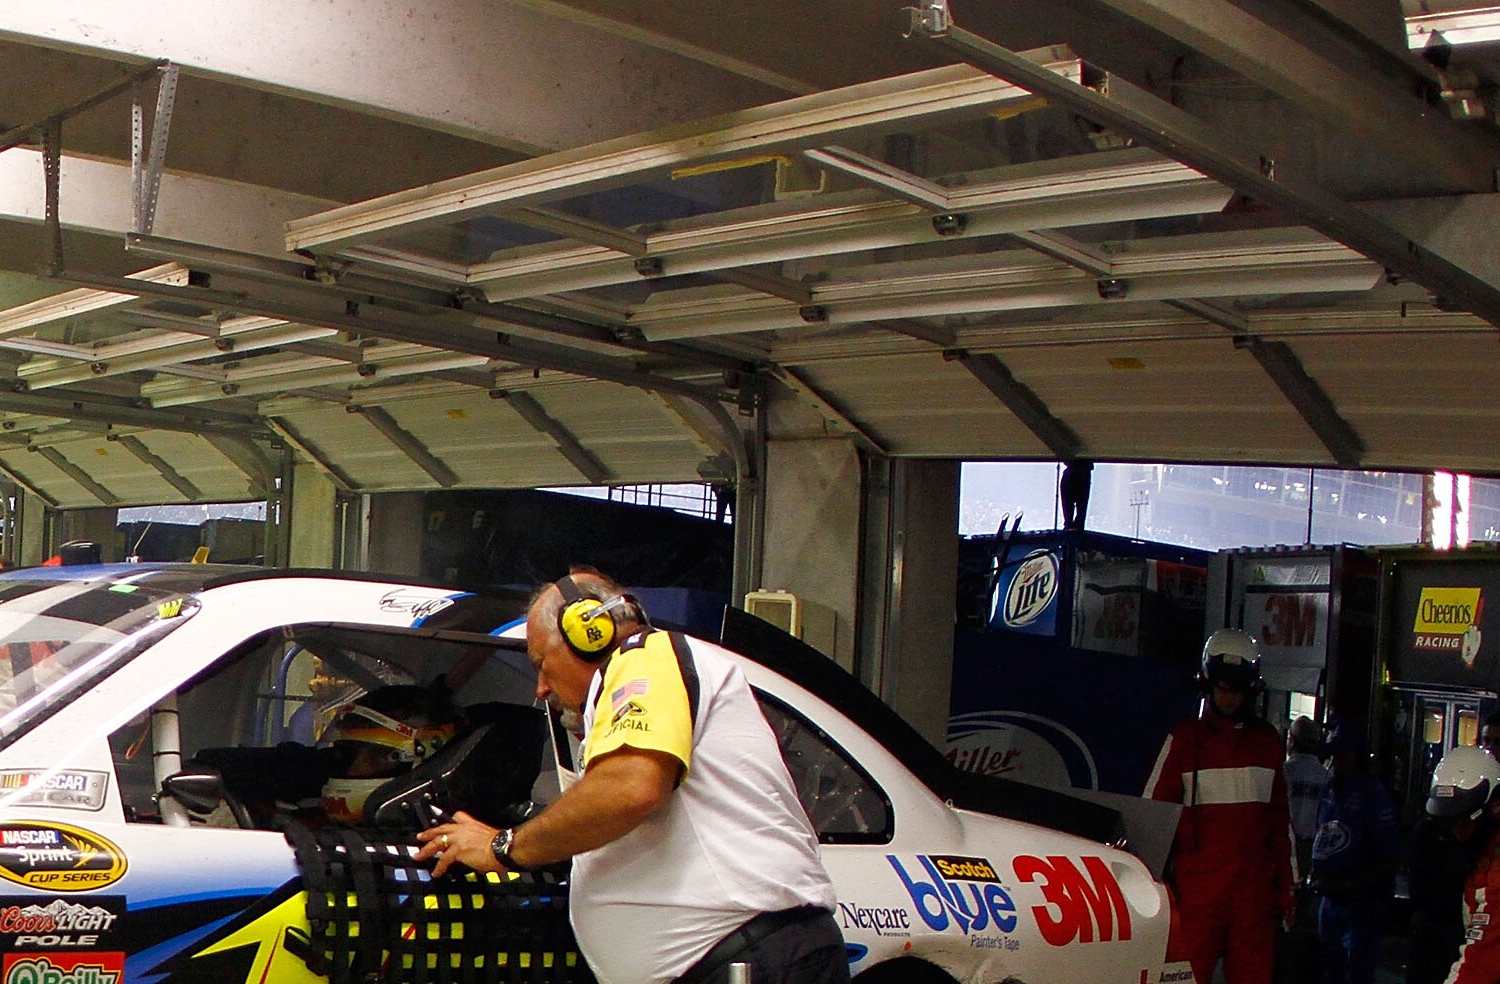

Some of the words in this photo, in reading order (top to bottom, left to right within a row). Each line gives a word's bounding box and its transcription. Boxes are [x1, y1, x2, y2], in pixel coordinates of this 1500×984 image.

[1420, 598, 1472, 626] Cheerios
[1415, 635, 1460, 649] RACING
[2, 830, 59, 845] NASCAR
[18, 844, 74, 866] Sprint
[29, 873, 59, 883] CUP
[61, 871, 111, 882] SERIES
[937, 858, 997, 880] Scotch
[886, 854, 1018, 936] blue
[1011, 854, 1133, 947] 3M
[0, 905, 56, 933] Coors
[56, 909, 117, 932] LIGHT
[838, 901, 911, 936] Nexcare
[14, 934, 100, 947] POLE
[1158, 969, 1194, 984] American
